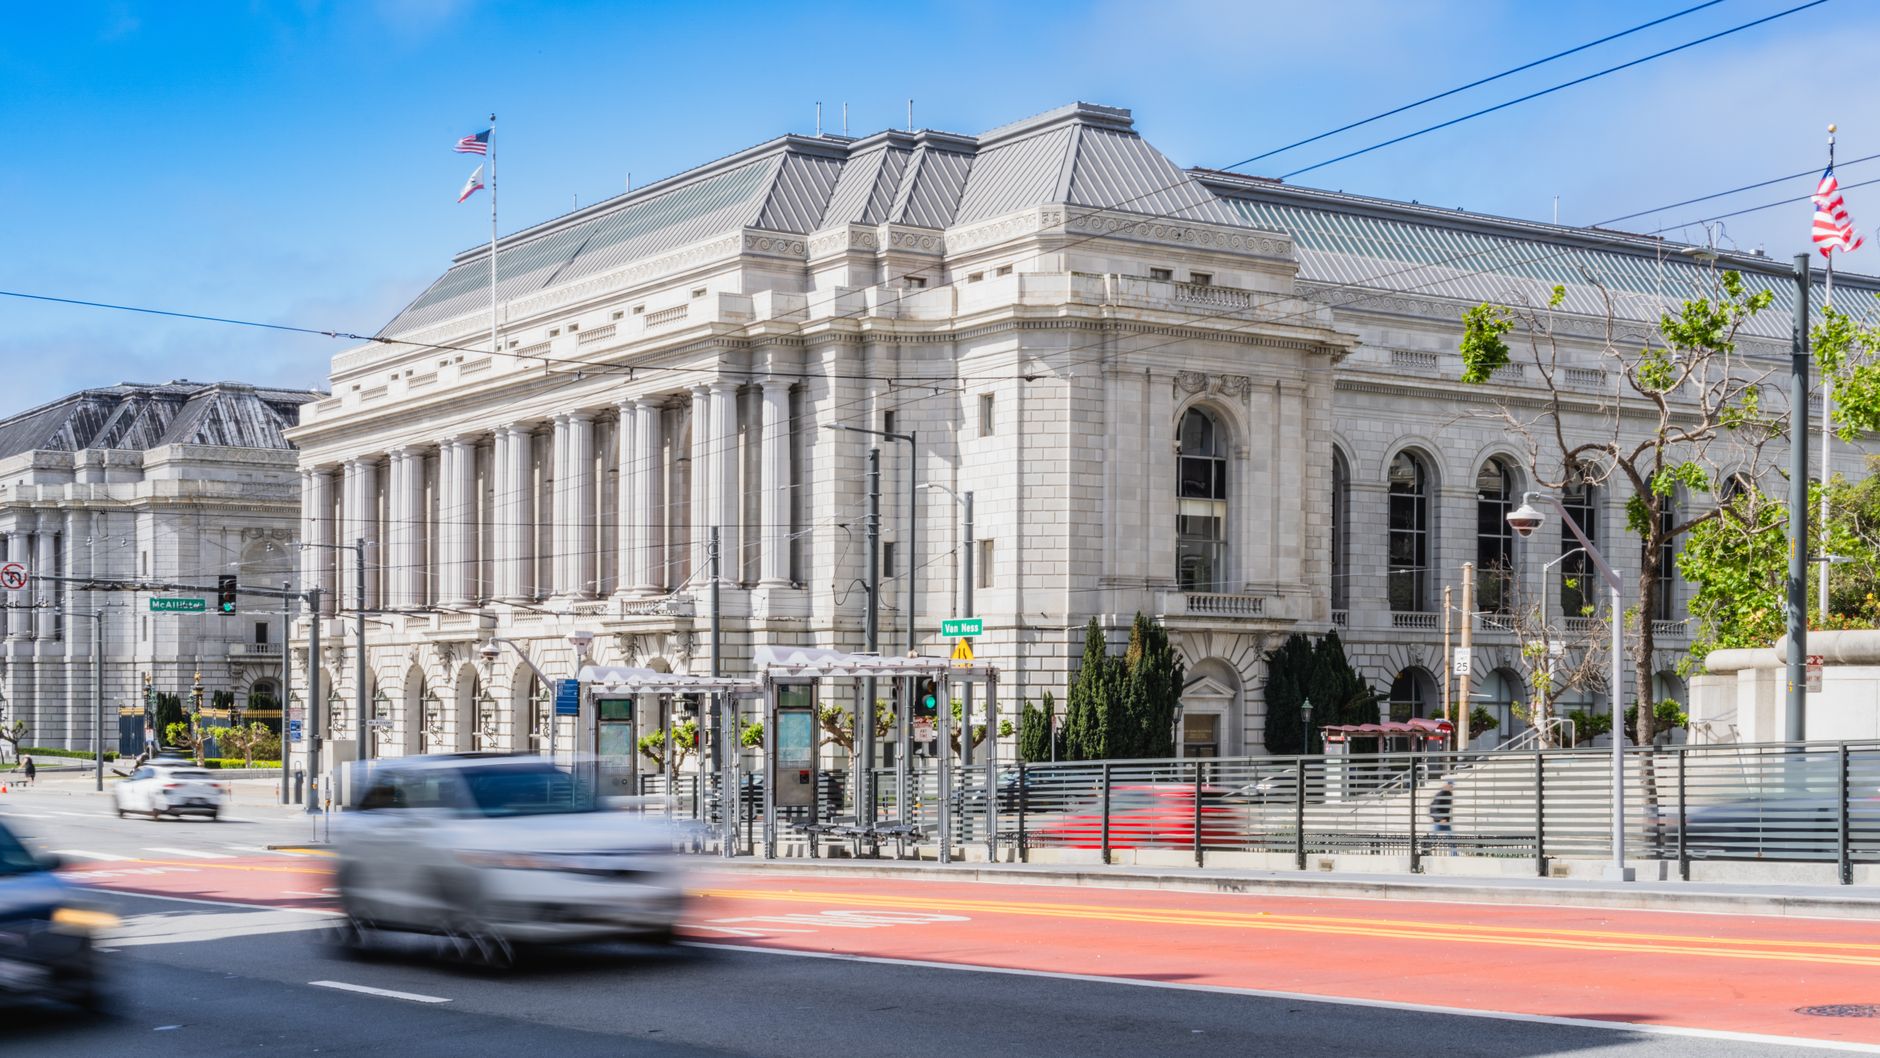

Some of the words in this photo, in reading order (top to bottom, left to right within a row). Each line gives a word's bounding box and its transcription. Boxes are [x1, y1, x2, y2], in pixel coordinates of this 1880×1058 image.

[944, 623, 959, 633] Van
[961, 623, 979, 633] Ness
[1456, 662, 1468, 672] 25
